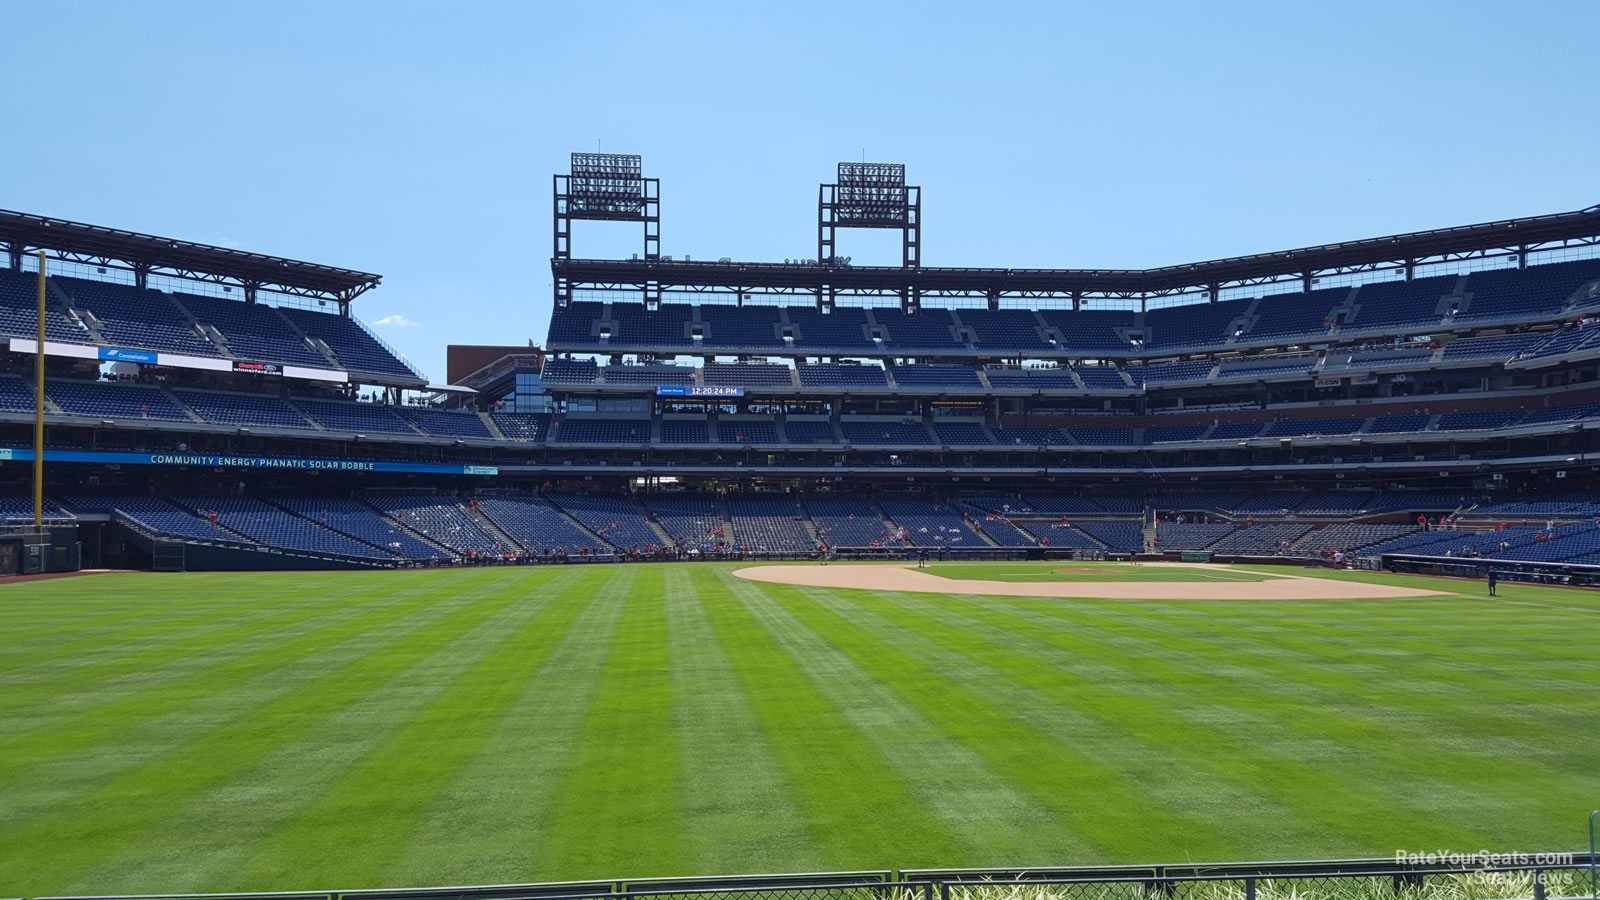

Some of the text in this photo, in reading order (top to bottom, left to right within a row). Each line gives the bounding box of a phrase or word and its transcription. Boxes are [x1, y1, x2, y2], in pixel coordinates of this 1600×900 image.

[233, 368, 282, 376] winnerford.com
[691, 387, 723, 395] 12:20:24
[150, 455, 374, 471] COMMUNITY ENERGY PHANATIC SOLAR BOBBLE
